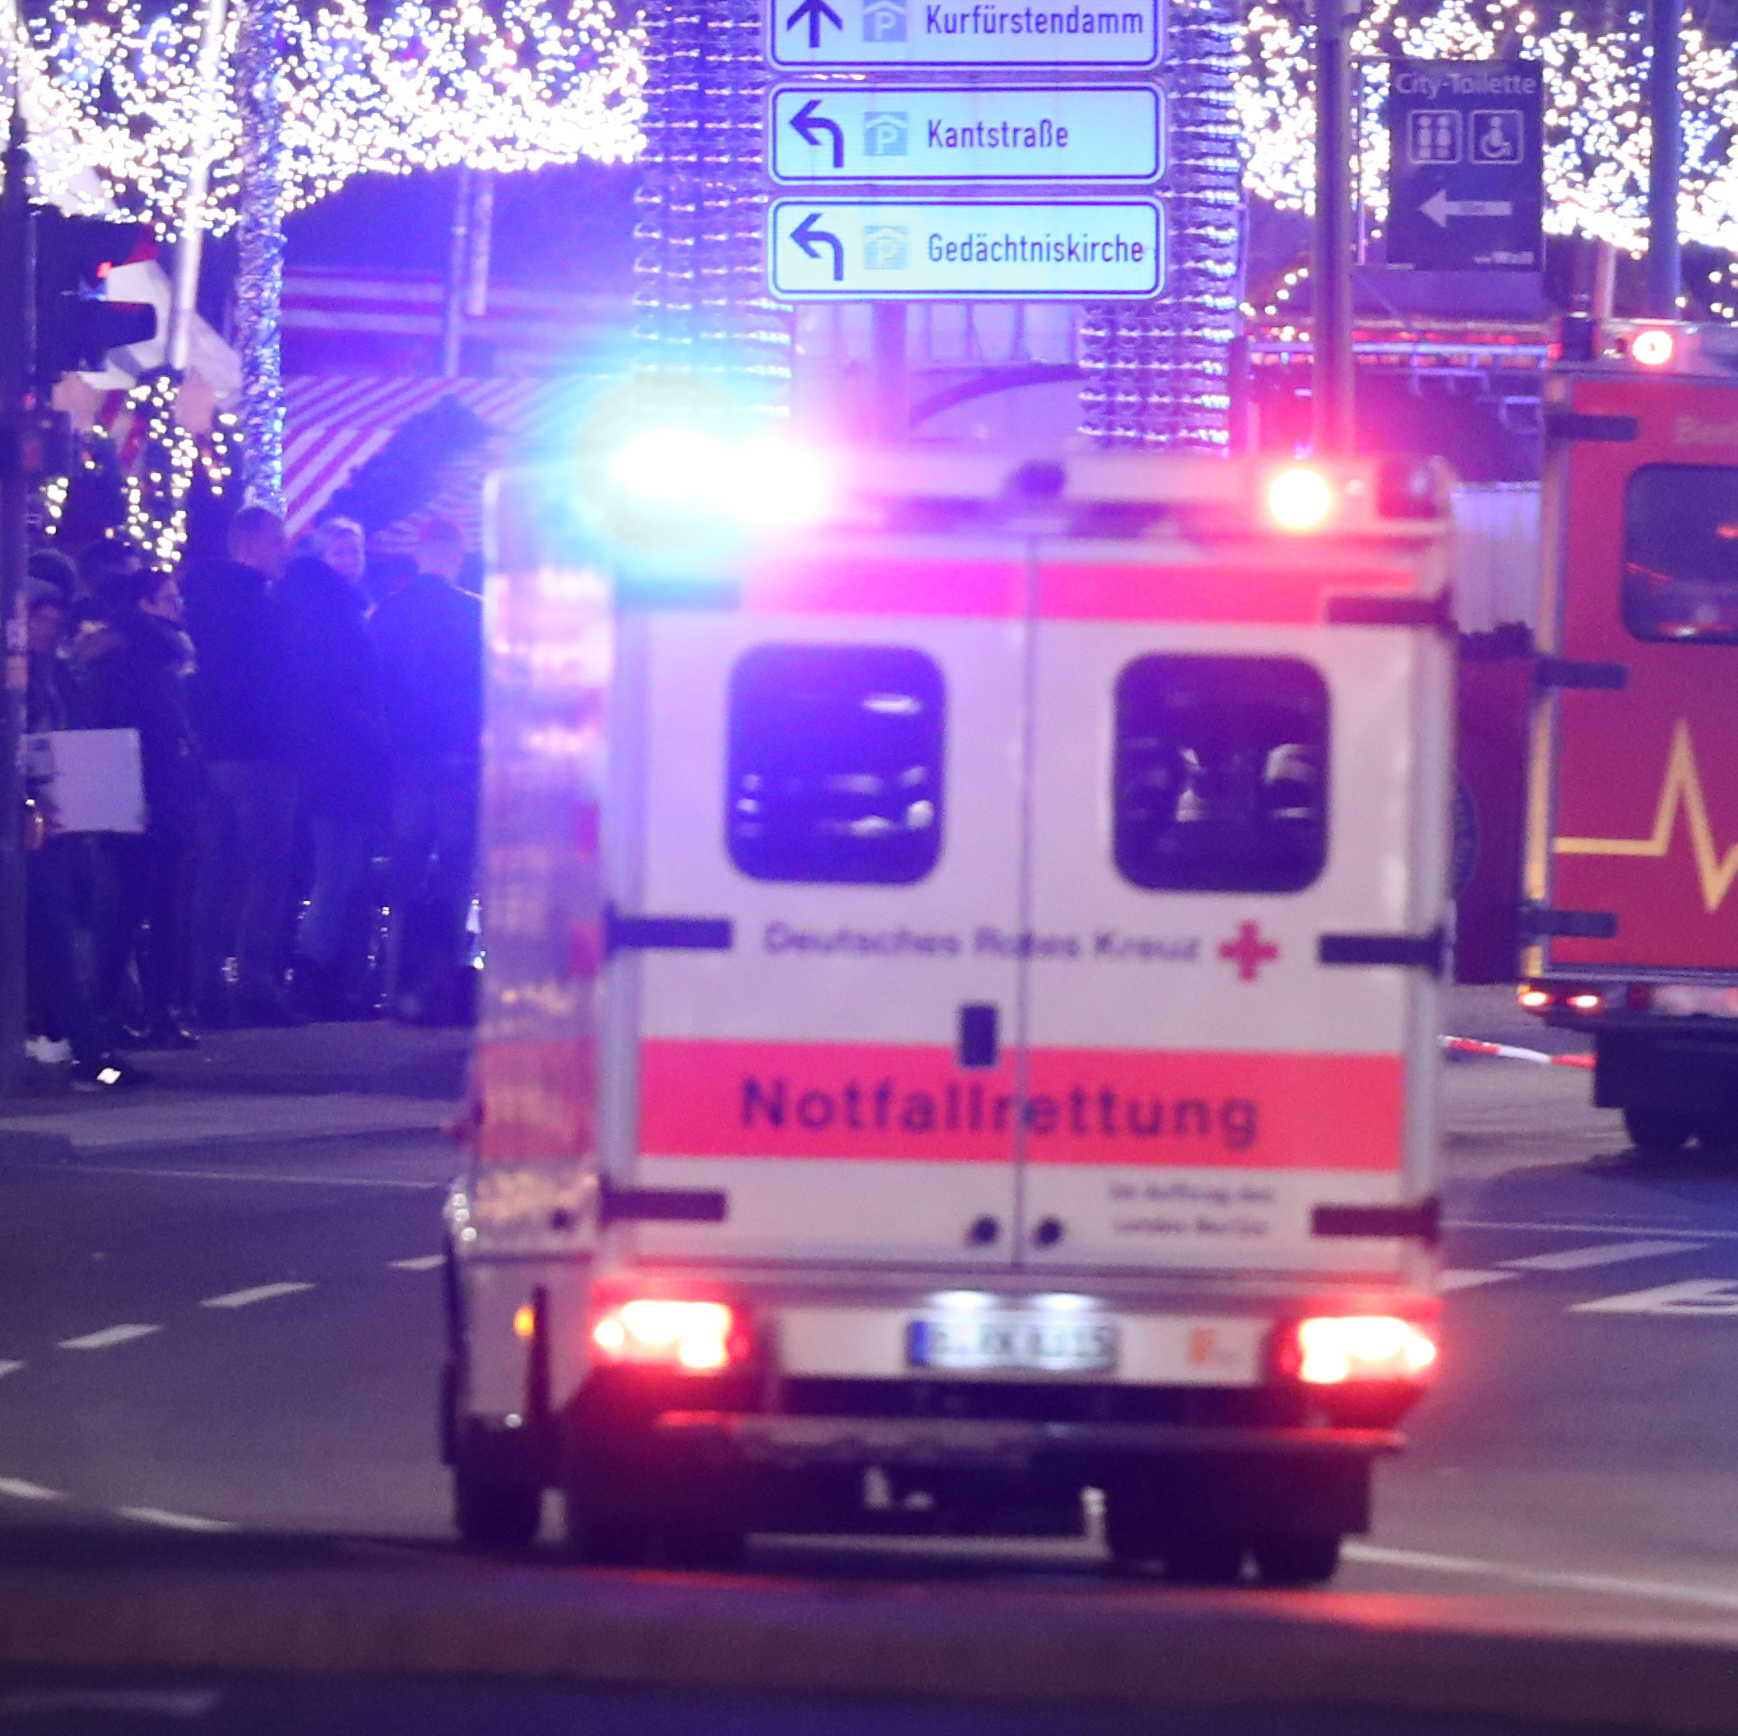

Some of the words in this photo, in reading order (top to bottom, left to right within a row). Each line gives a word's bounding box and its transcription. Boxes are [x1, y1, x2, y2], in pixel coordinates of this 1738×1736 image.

[926, 4, 1143, 34] Kurfürstendamm
[1394, 73, 1538, 101] City-Toilette
[927, 118, 1069, 148] Kantstraße
[928, 232, 1144, 263] Gedächtniskirche
[741, 1077, 1259, 1151] Notfallrettung
